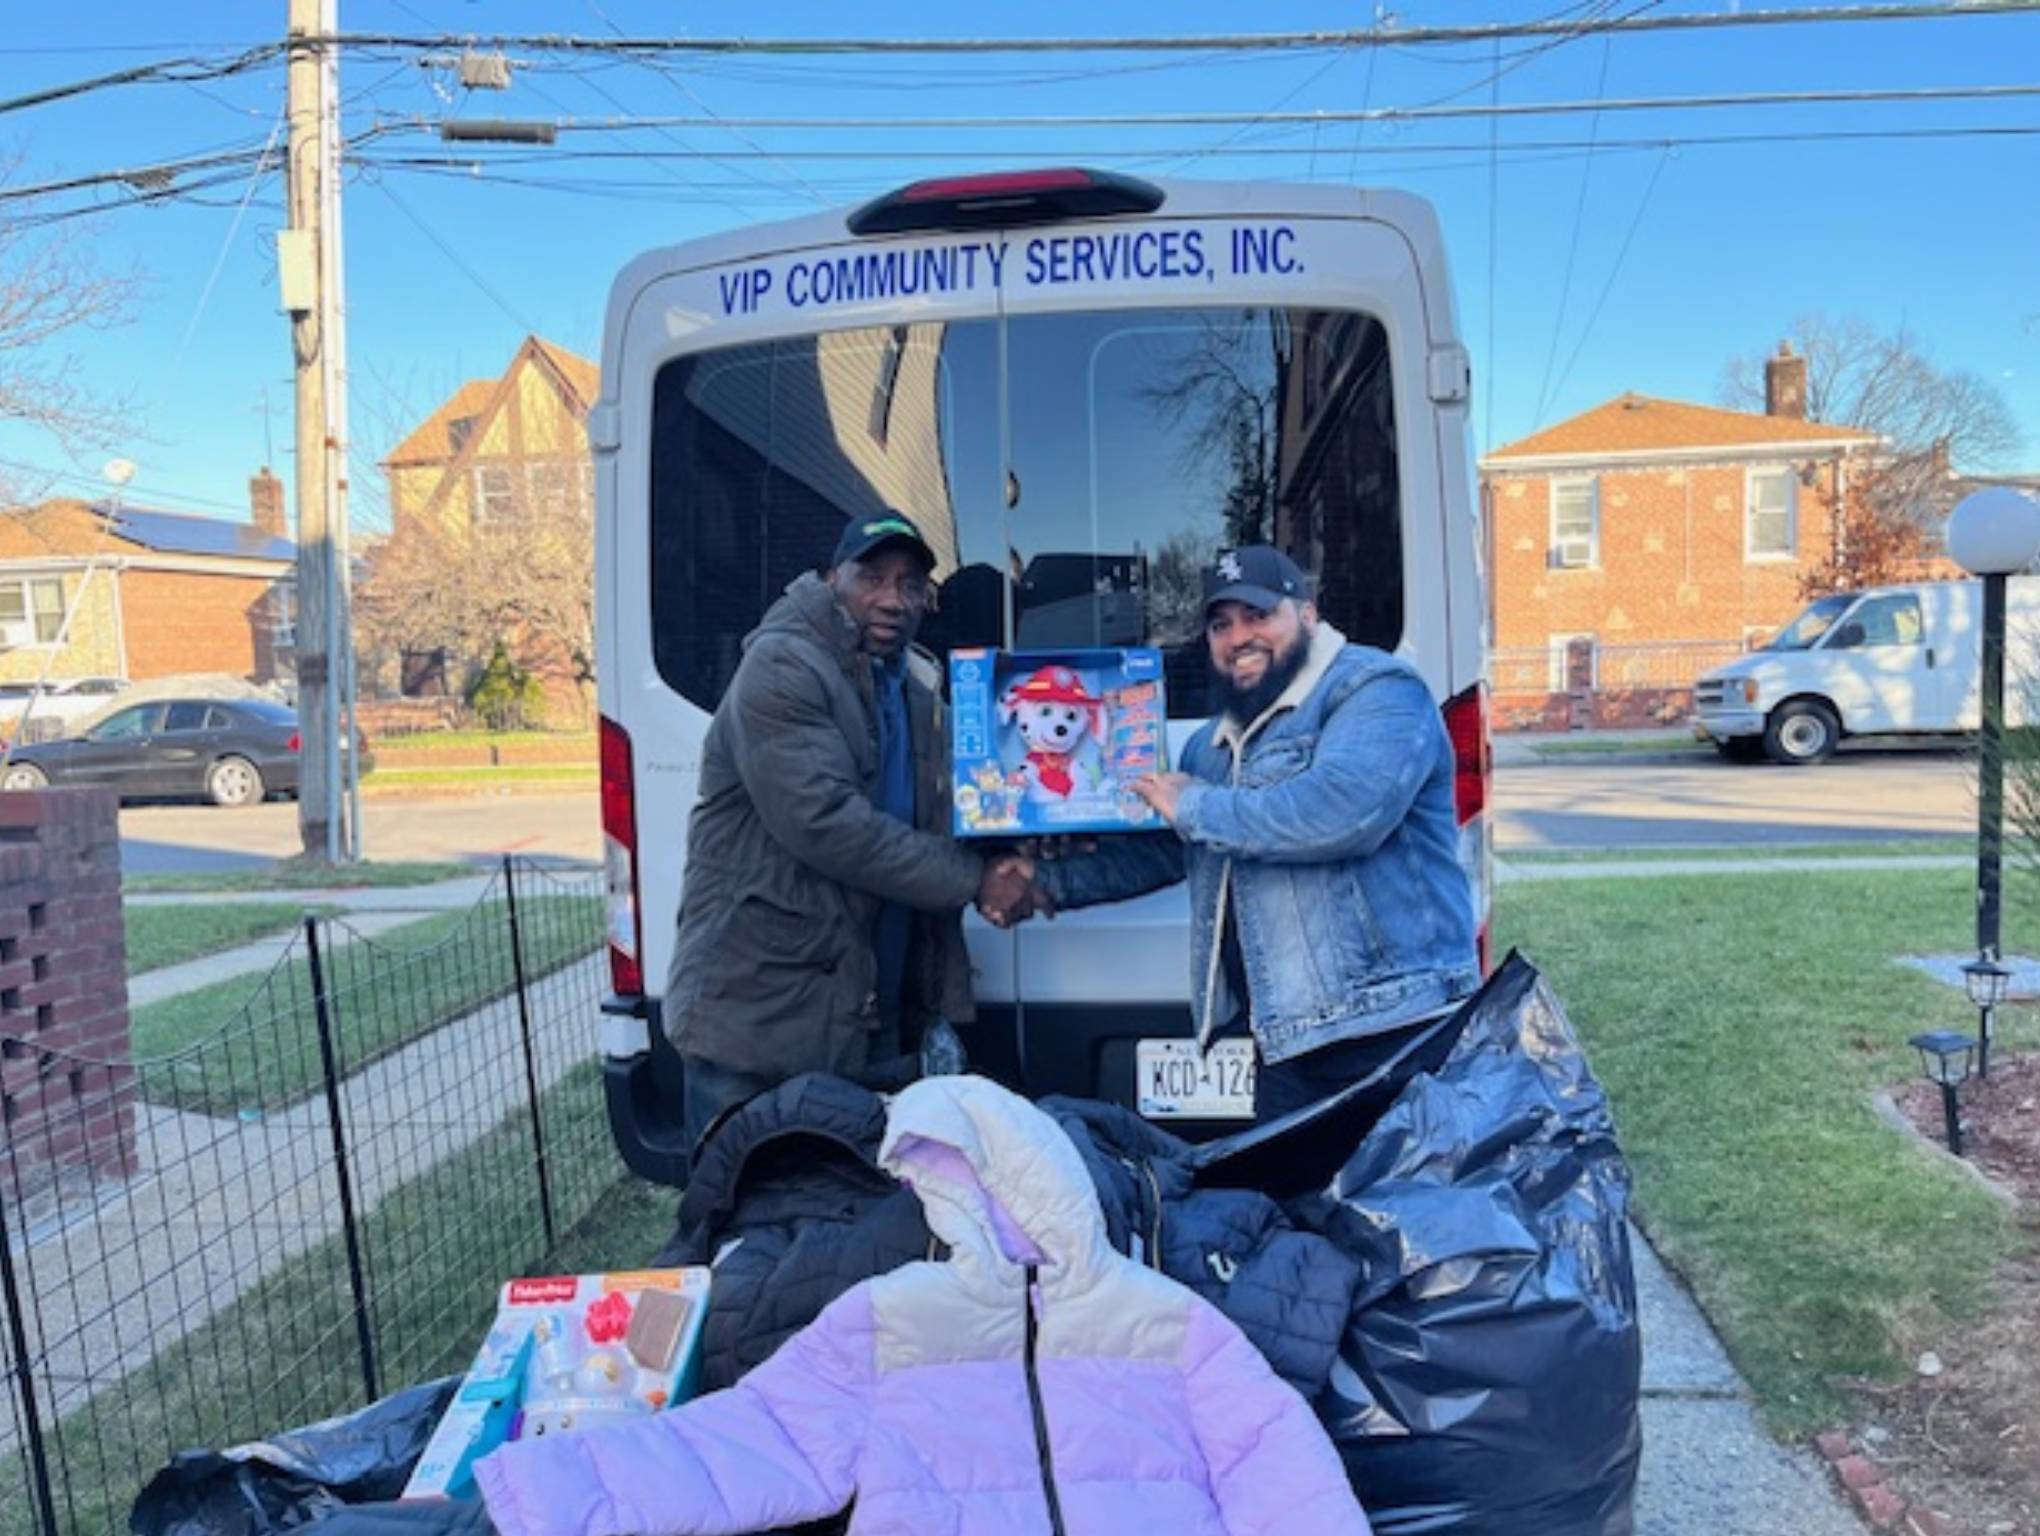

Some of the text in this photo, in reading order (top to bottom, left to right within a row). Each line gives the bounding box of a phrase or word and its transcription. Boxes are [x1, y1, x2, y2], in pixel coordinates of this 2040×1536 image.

[720, 226, 1305, 315] VIP COMMUNITY SERVICES, INC.
